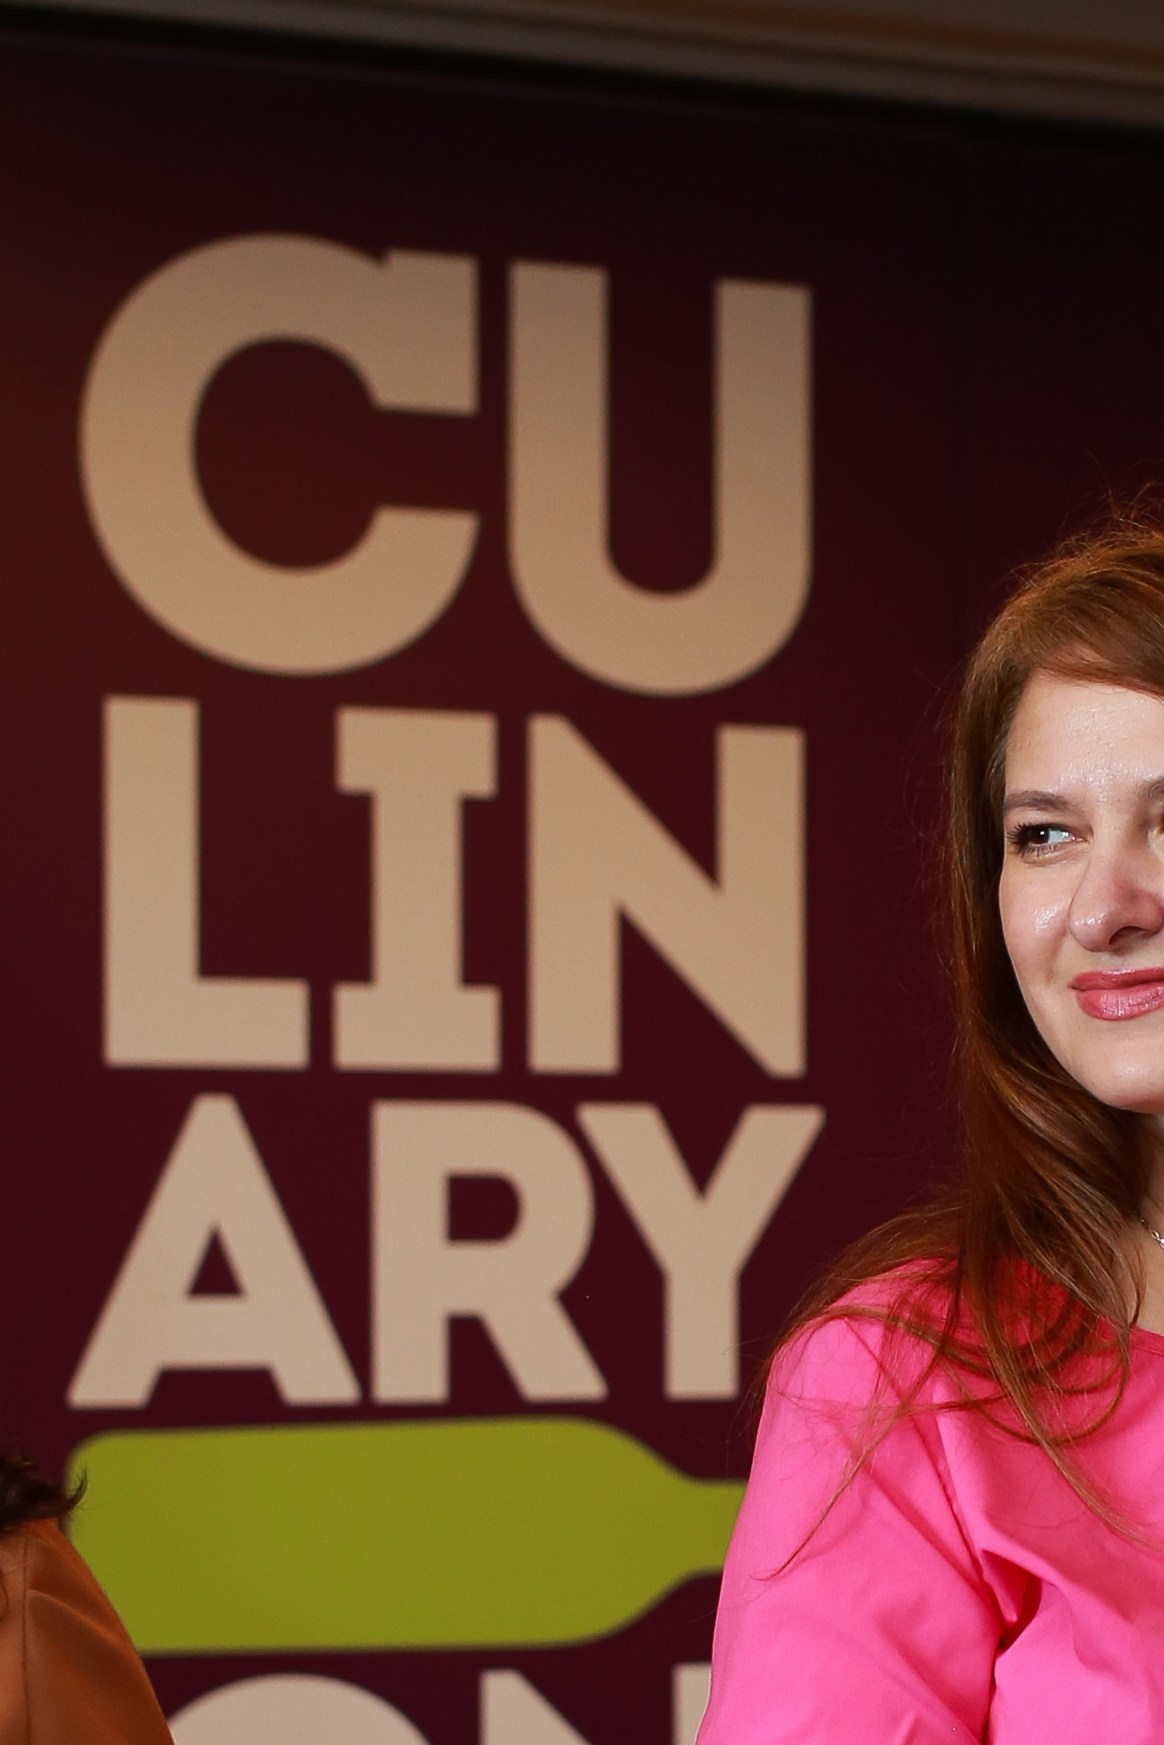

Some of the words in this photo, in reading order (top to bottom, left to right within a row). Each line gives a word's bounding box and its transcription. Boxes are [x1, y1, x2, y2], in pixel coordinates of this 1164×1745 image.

[79, 233, 812, 696] CU
[103, 694, 806, 1077] LIN
[66, 1092, 826, 1409] ARY
